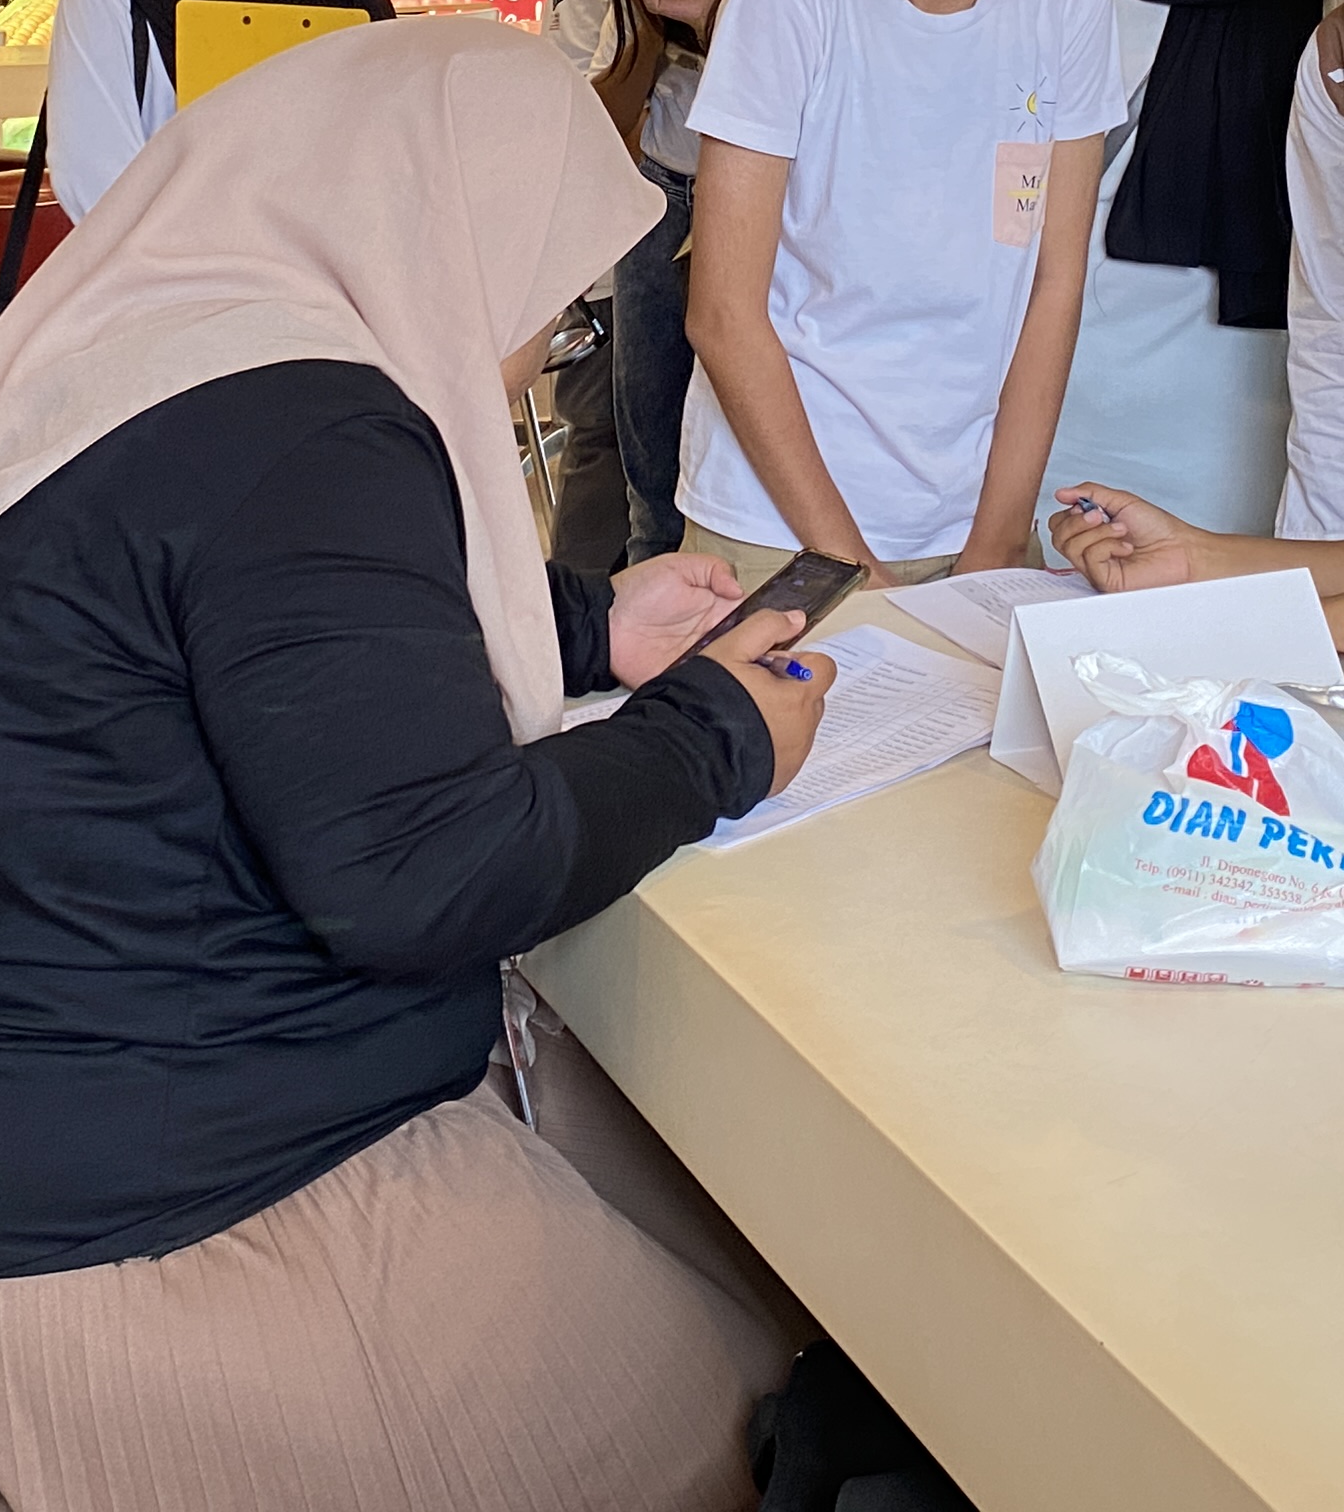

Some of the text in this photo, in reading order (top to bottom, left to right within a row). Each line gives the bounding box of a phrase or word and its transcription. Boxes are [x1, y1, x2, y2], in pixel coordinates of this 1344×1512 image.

[1142, 790, 1247, 843] DIAN
[1166, 865, 1206, 885] (0911)
[1259, 884, 1303, 905] 353538
[1217, 859, 1287, 886] Diponegoro
[1161, 882, 1202, 899] e-mail
